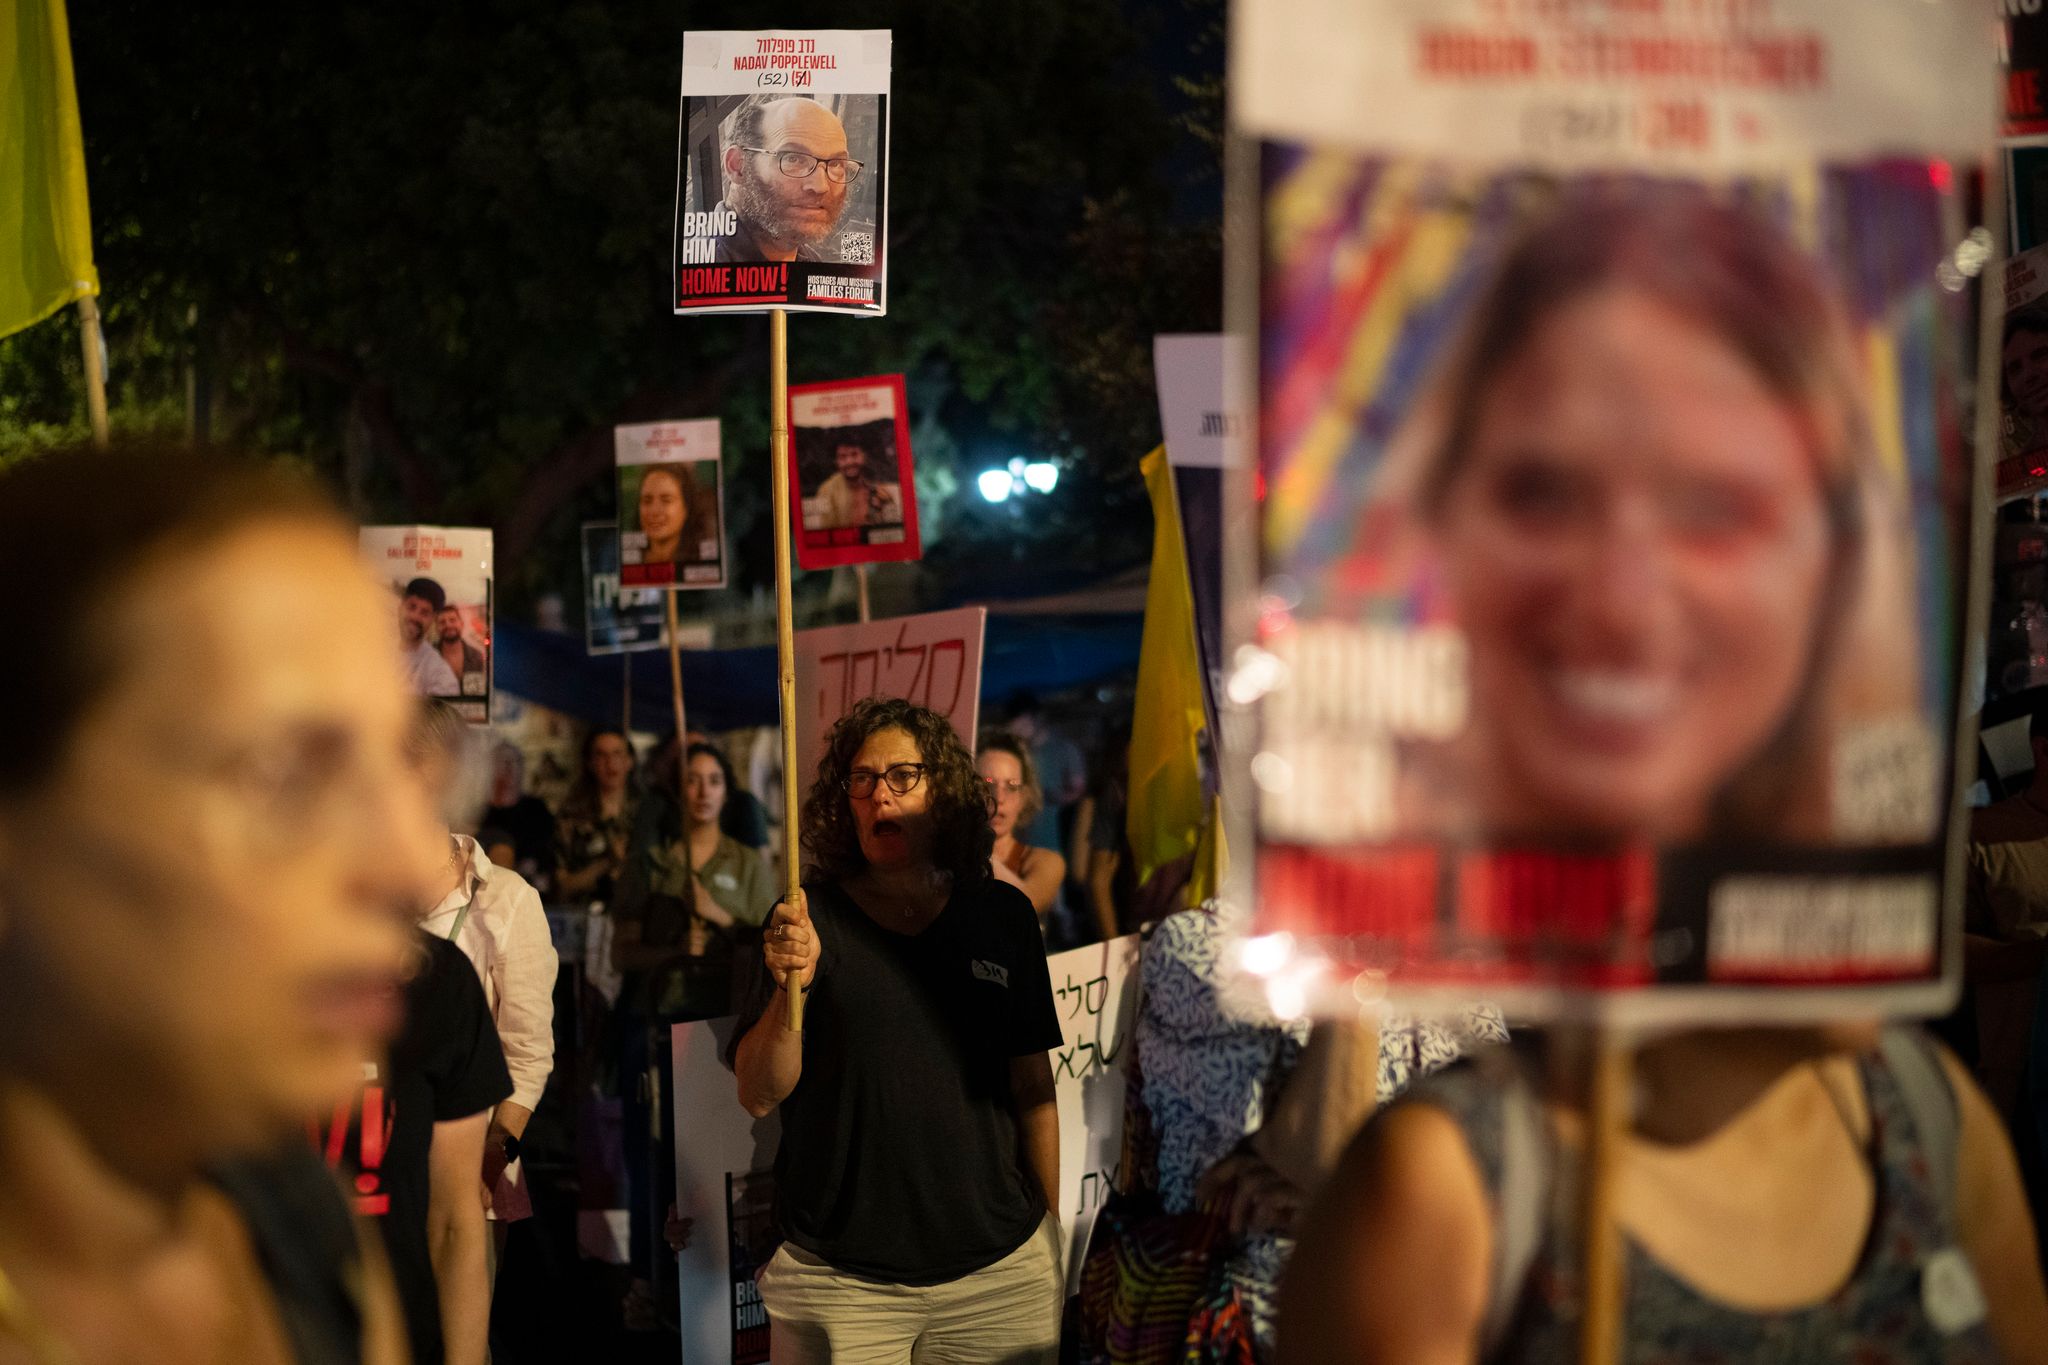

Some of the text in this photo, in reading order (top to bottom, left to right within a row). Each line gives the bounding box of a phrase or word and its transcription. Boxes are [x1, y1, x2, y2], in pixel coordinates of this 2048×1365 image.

[756, 38, 815, 53] נדב פופלוול
[733, 55, 837, 70] NADAV POPPLEWELL
[757, 72, 789, 87] (52)
[683, 211, 737, 237] BRING
[682, 238, 716, 265] HIM
[682, 263, 787, 295] HOME NOW!
[807, 275, 874, 288] HOSTAGES AND MISSING
[807, 284, 874, 301] FAMILIES FORUM
[819, 622, 966, 720] סליחה
[1056, 974, 1108, 1020] סלי
[1055, 1032, 1125, 1085] שלא
[1076, 1163, 1120, 1216] את
